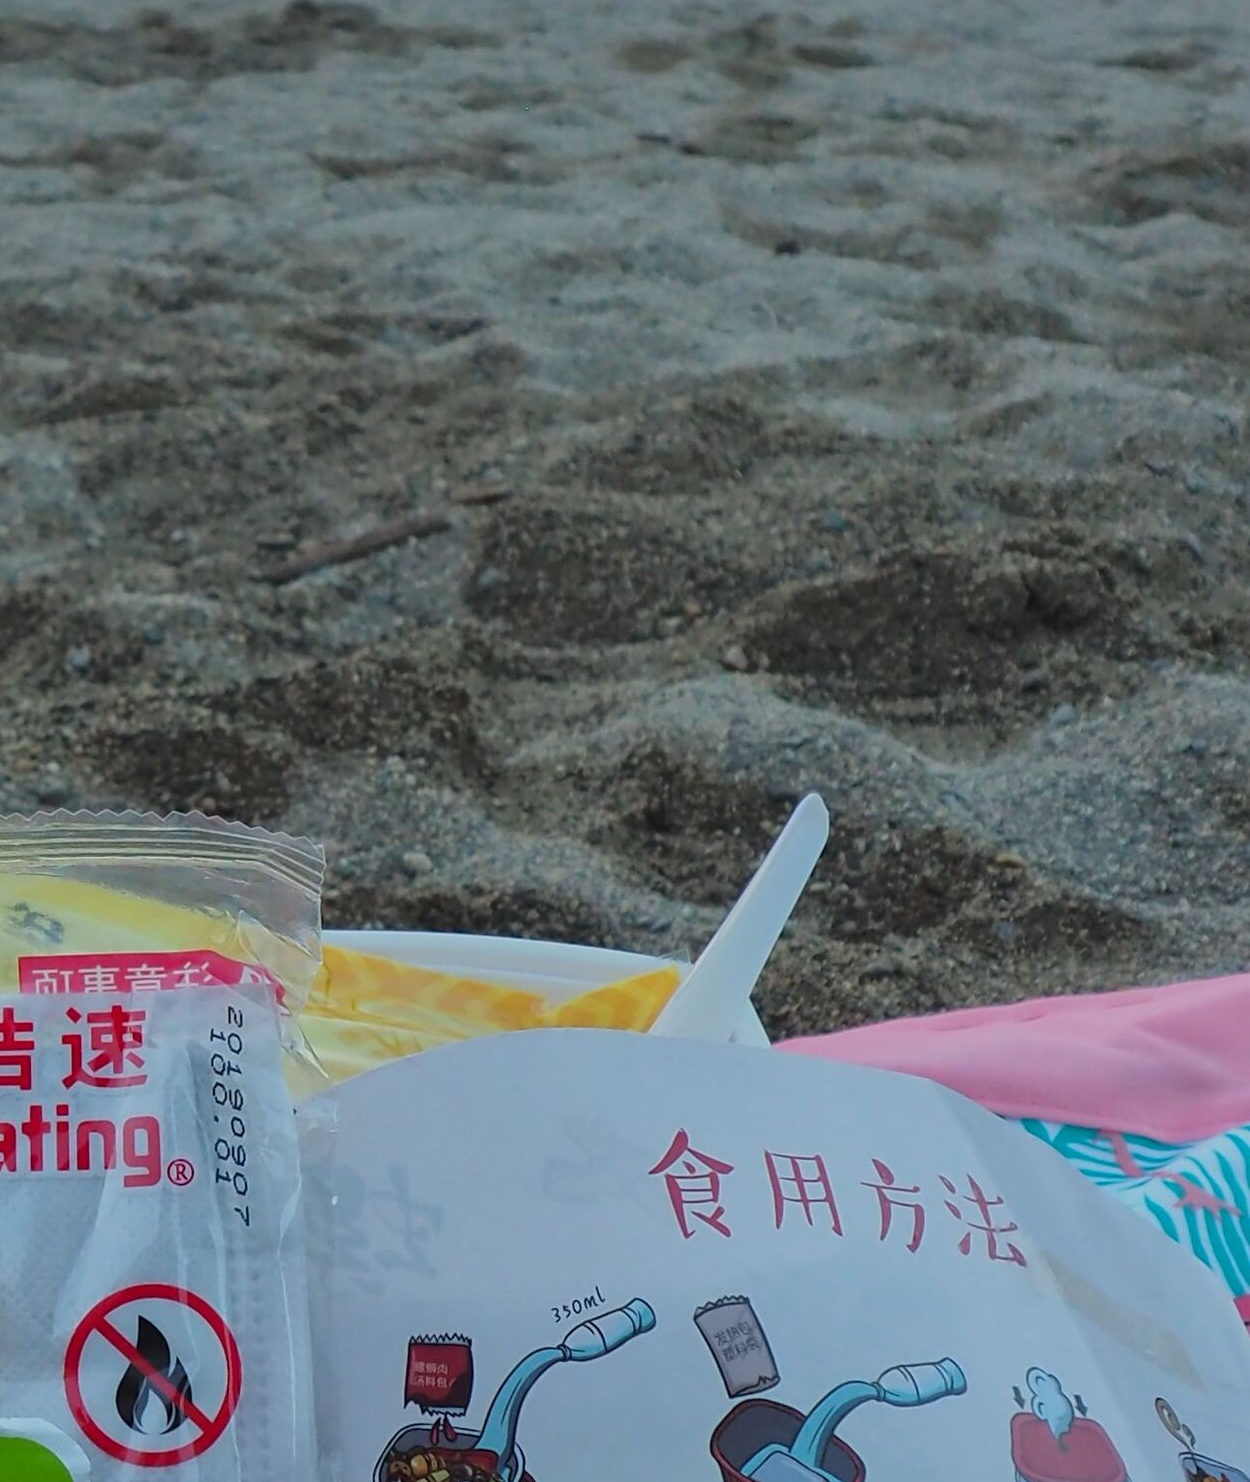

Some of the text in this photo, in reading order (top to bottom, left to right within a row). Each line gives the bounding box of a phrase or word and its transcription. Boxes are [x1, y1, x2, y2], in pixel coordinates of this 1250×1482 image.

[225, 1005, 250, 1226] 20190907
[647, 1126, 1028, 1268] 食用方法
[550, 1285, 606, 1323] 350ml
